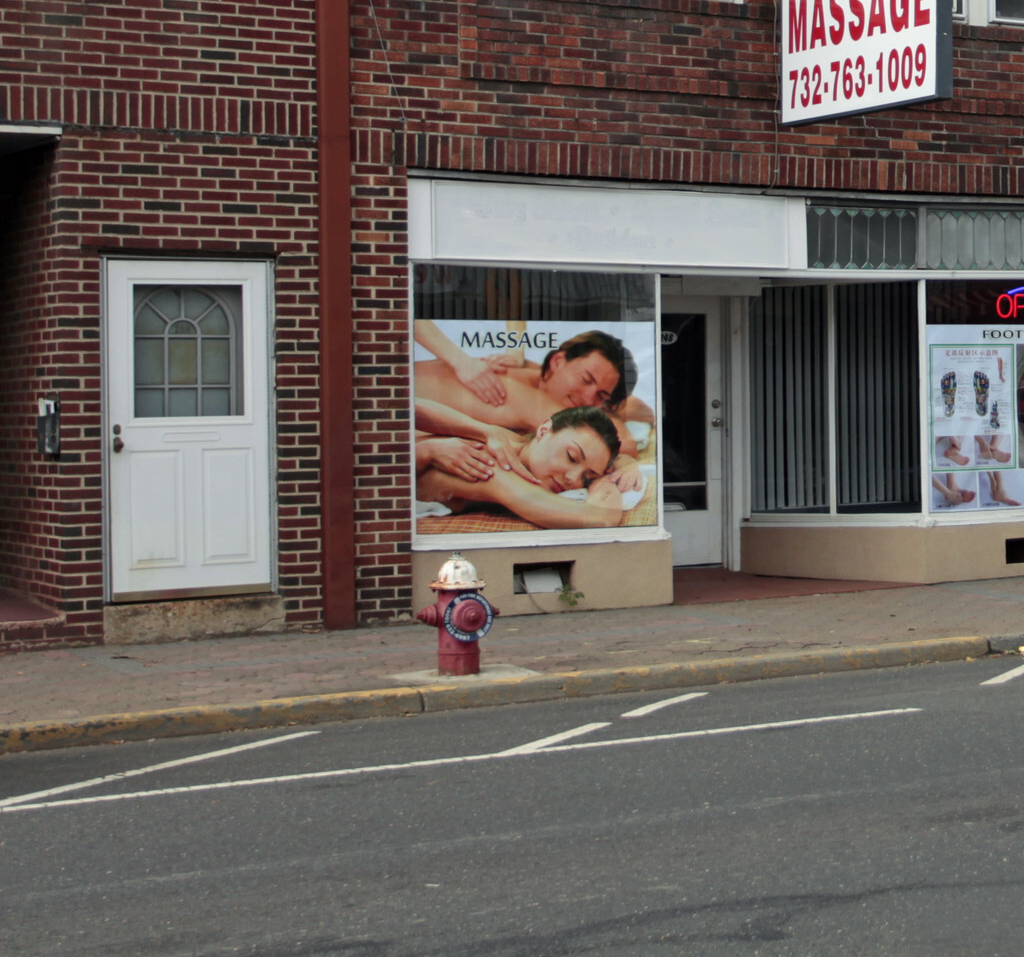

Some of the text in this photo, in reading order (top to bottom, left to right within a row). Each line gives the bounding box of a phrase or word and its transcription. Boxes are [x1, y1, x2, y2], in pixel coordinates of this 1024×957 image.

[789, 43, 927, 109] 732-763-1009
[461, 331, 558, 349] MASSAGE
[983, 329, 1024, 339] FOOT
